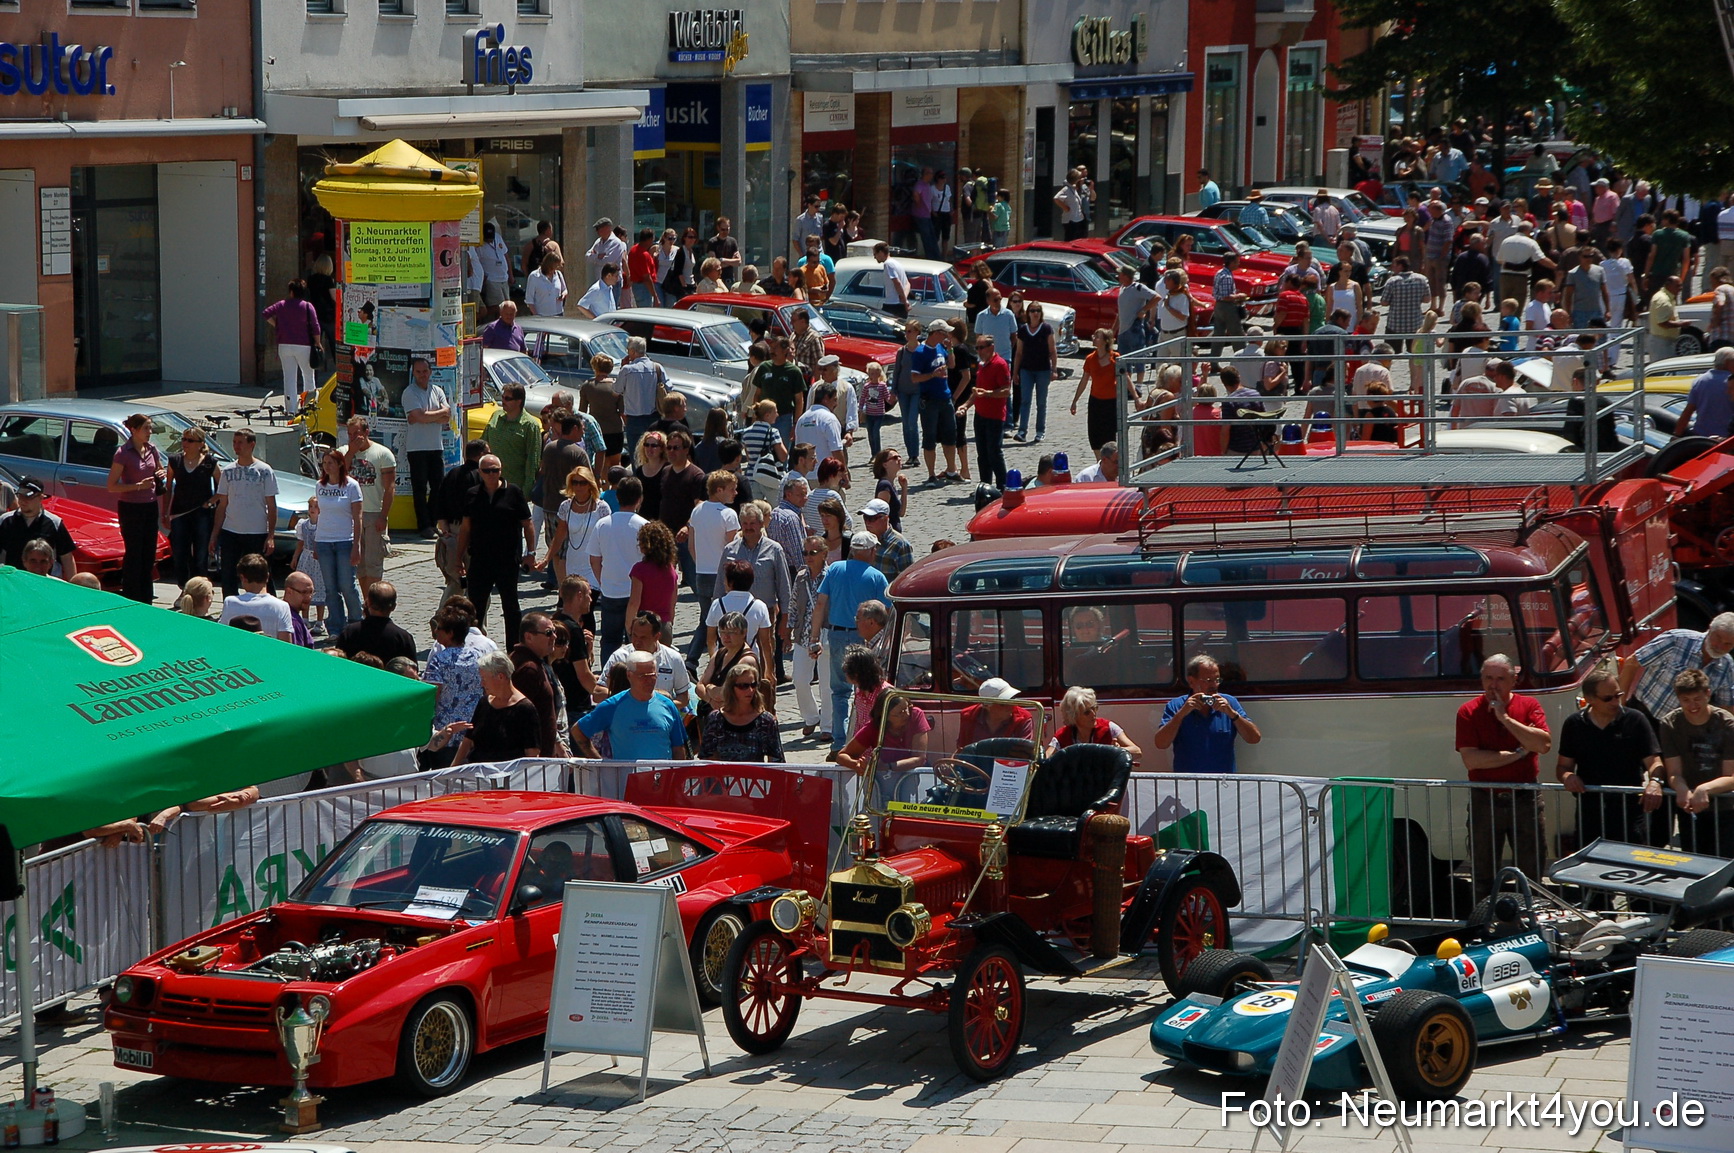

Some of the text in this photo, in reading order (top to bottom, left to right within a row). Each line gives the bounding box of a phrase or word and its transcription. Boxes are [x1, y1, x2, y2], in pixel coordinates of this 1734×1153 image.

[672, 9, 744, 48] Weltbild
[473, 22, 533, 86] fries
[665, 101, 709, 125] usik
[748, 105, 769, 122] Bücher
[490, 139, 534, 150] FRIES
[356, 226, 422, 236] 3. Neumarkter
[354, 236, 424, 245] Oldtimertreffen
[353, 247, 381, 255] Sonntag,
[74, 655, 213, 698] Neumarkter
[66, 667, 265, 725] Lammsbräu
[106, 689, 286, 742] DAS FEINE ÖKOLOGISCHE BIER
[902, 803, 982, 819] auto neuser nürnberg
[1599, 869, 1678, 886] elf
[1487, 933, 1543, 954] DEPAILLER
[1493, 961, 1521, 982] BBS
[1461, 976, 1478, 989] elf
[1246, 995, 1287, 1008] 28
[1168, 1019, 1187, 1029] elf
[114, 1047, 142, 1066] Mobil
